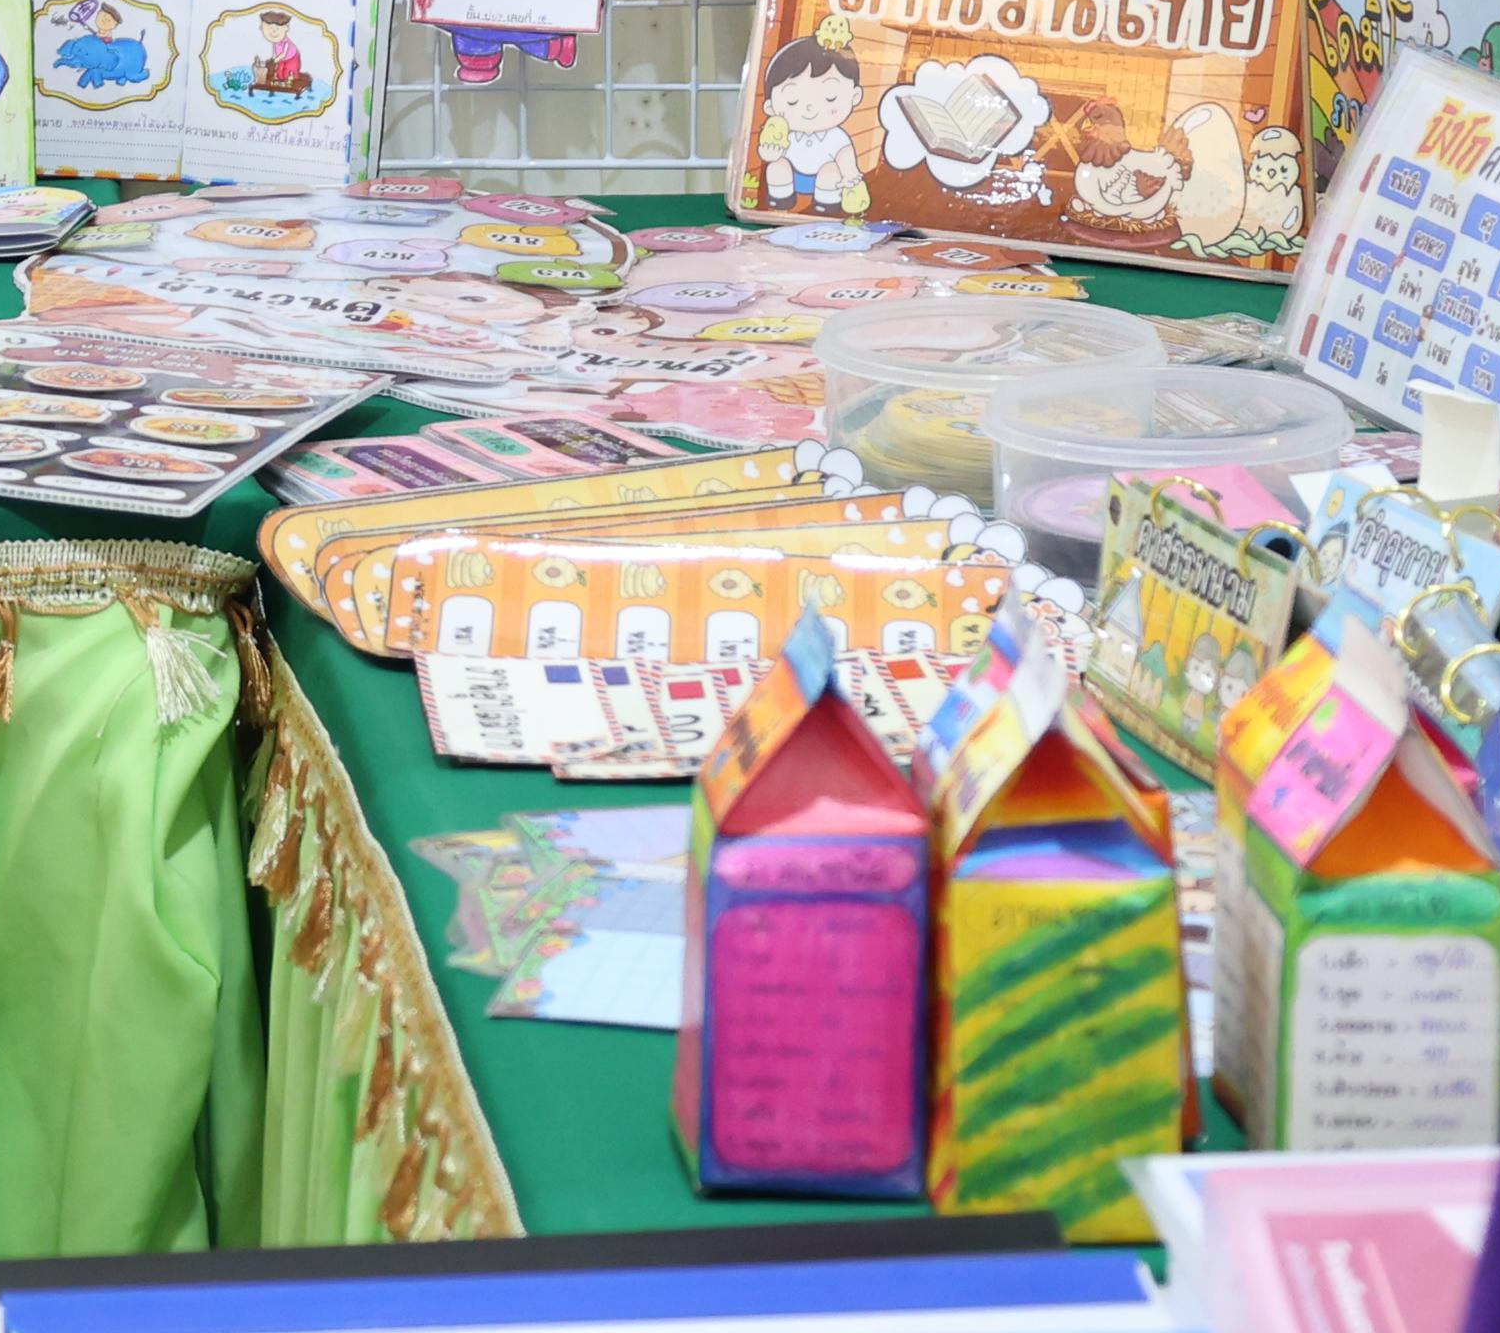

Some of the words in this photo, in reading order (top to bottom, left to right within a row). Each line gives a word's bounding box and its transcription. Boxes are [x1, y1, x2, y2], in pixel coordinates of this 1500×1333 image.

[1138, 514, 1258, 625] คำสรรพนาม
[1350, 510, 1449, 586] คำอุทาน
